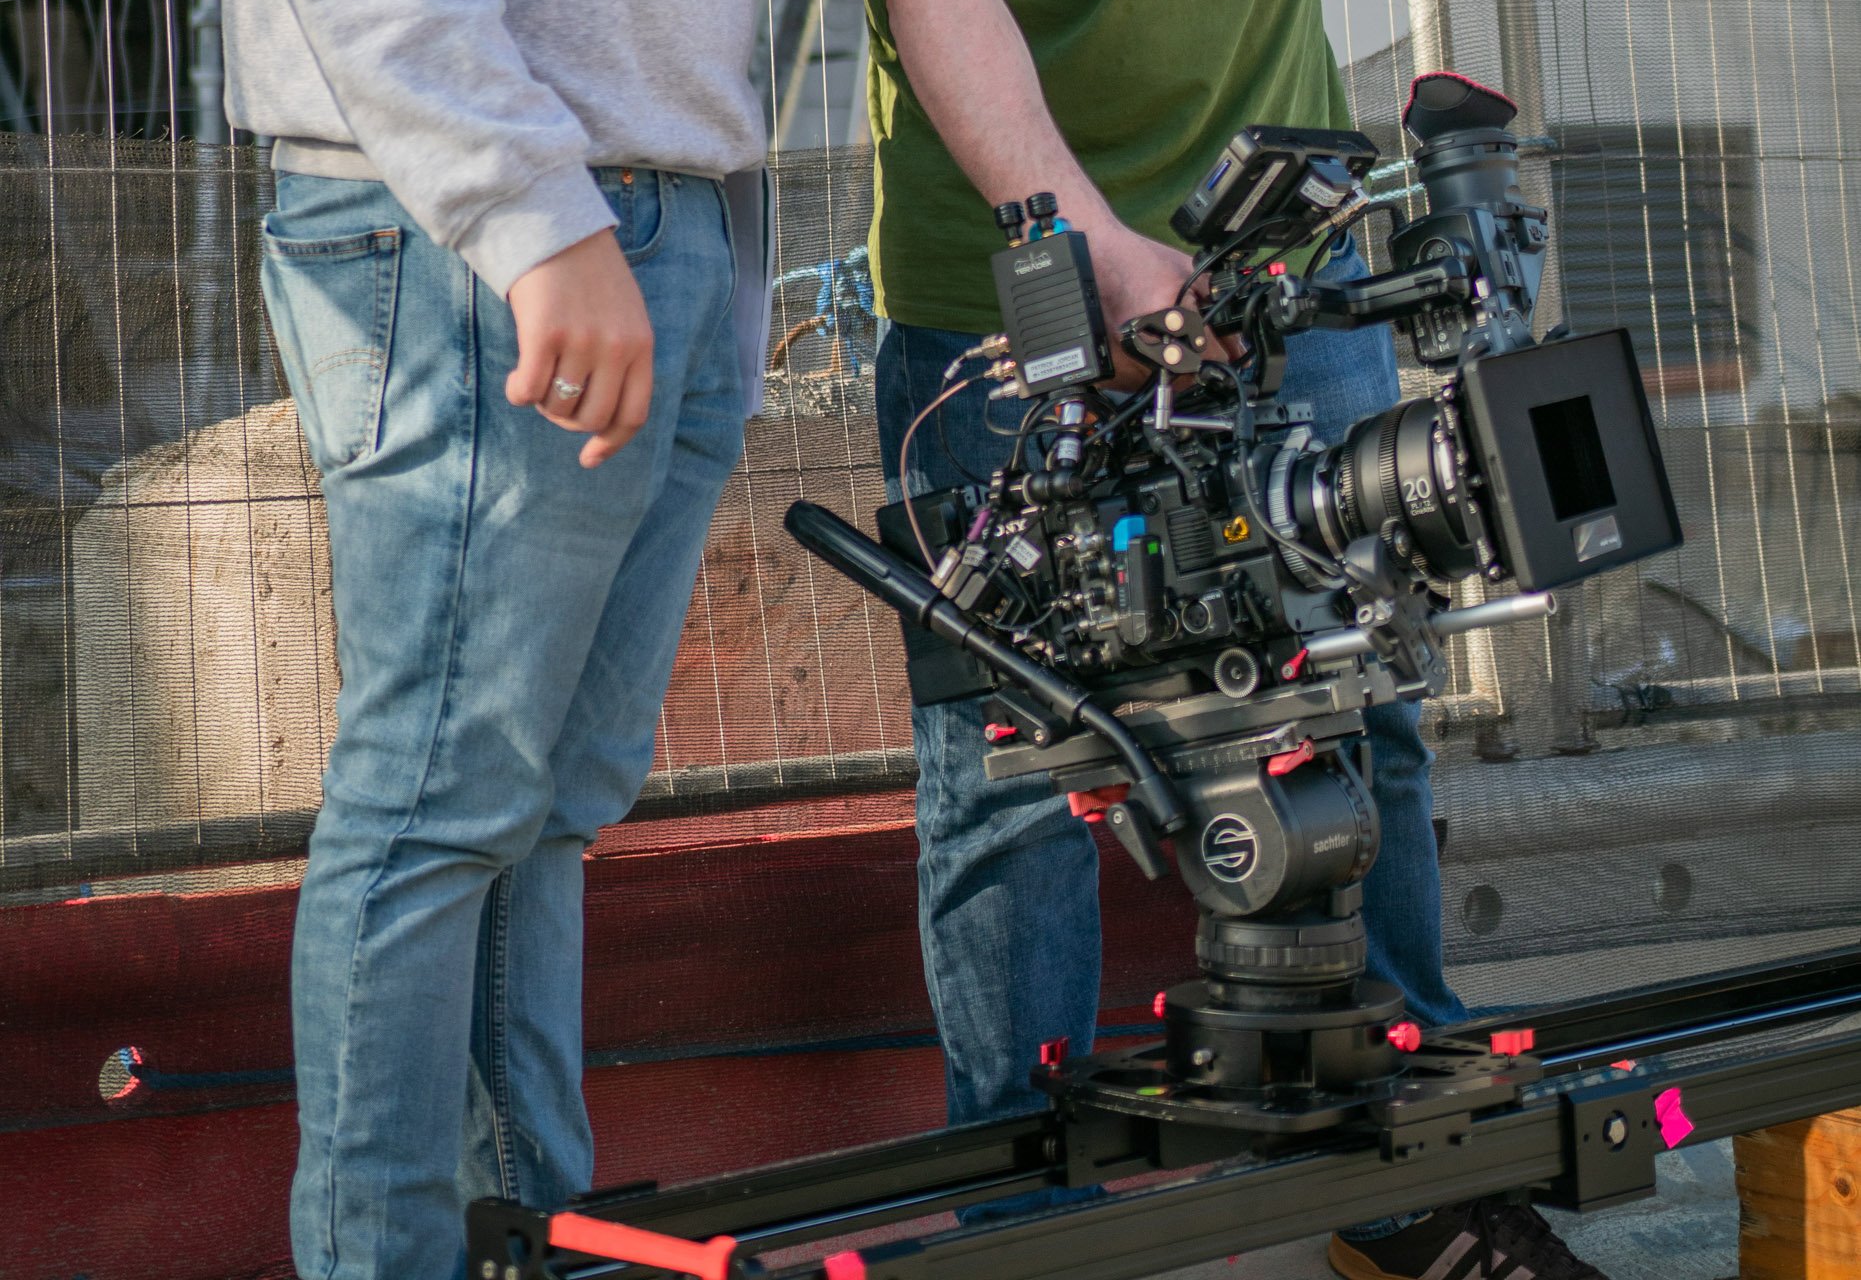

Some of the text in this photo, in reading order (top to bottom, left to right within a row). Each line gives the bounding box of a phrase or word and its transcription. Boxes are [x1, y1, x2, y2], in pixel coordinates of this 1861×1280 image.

[1014, 259, 1052, 276] TERADEK
[1403, 478, 1431, 502] 20
[1313, 833, 1350, 854] sachtler
